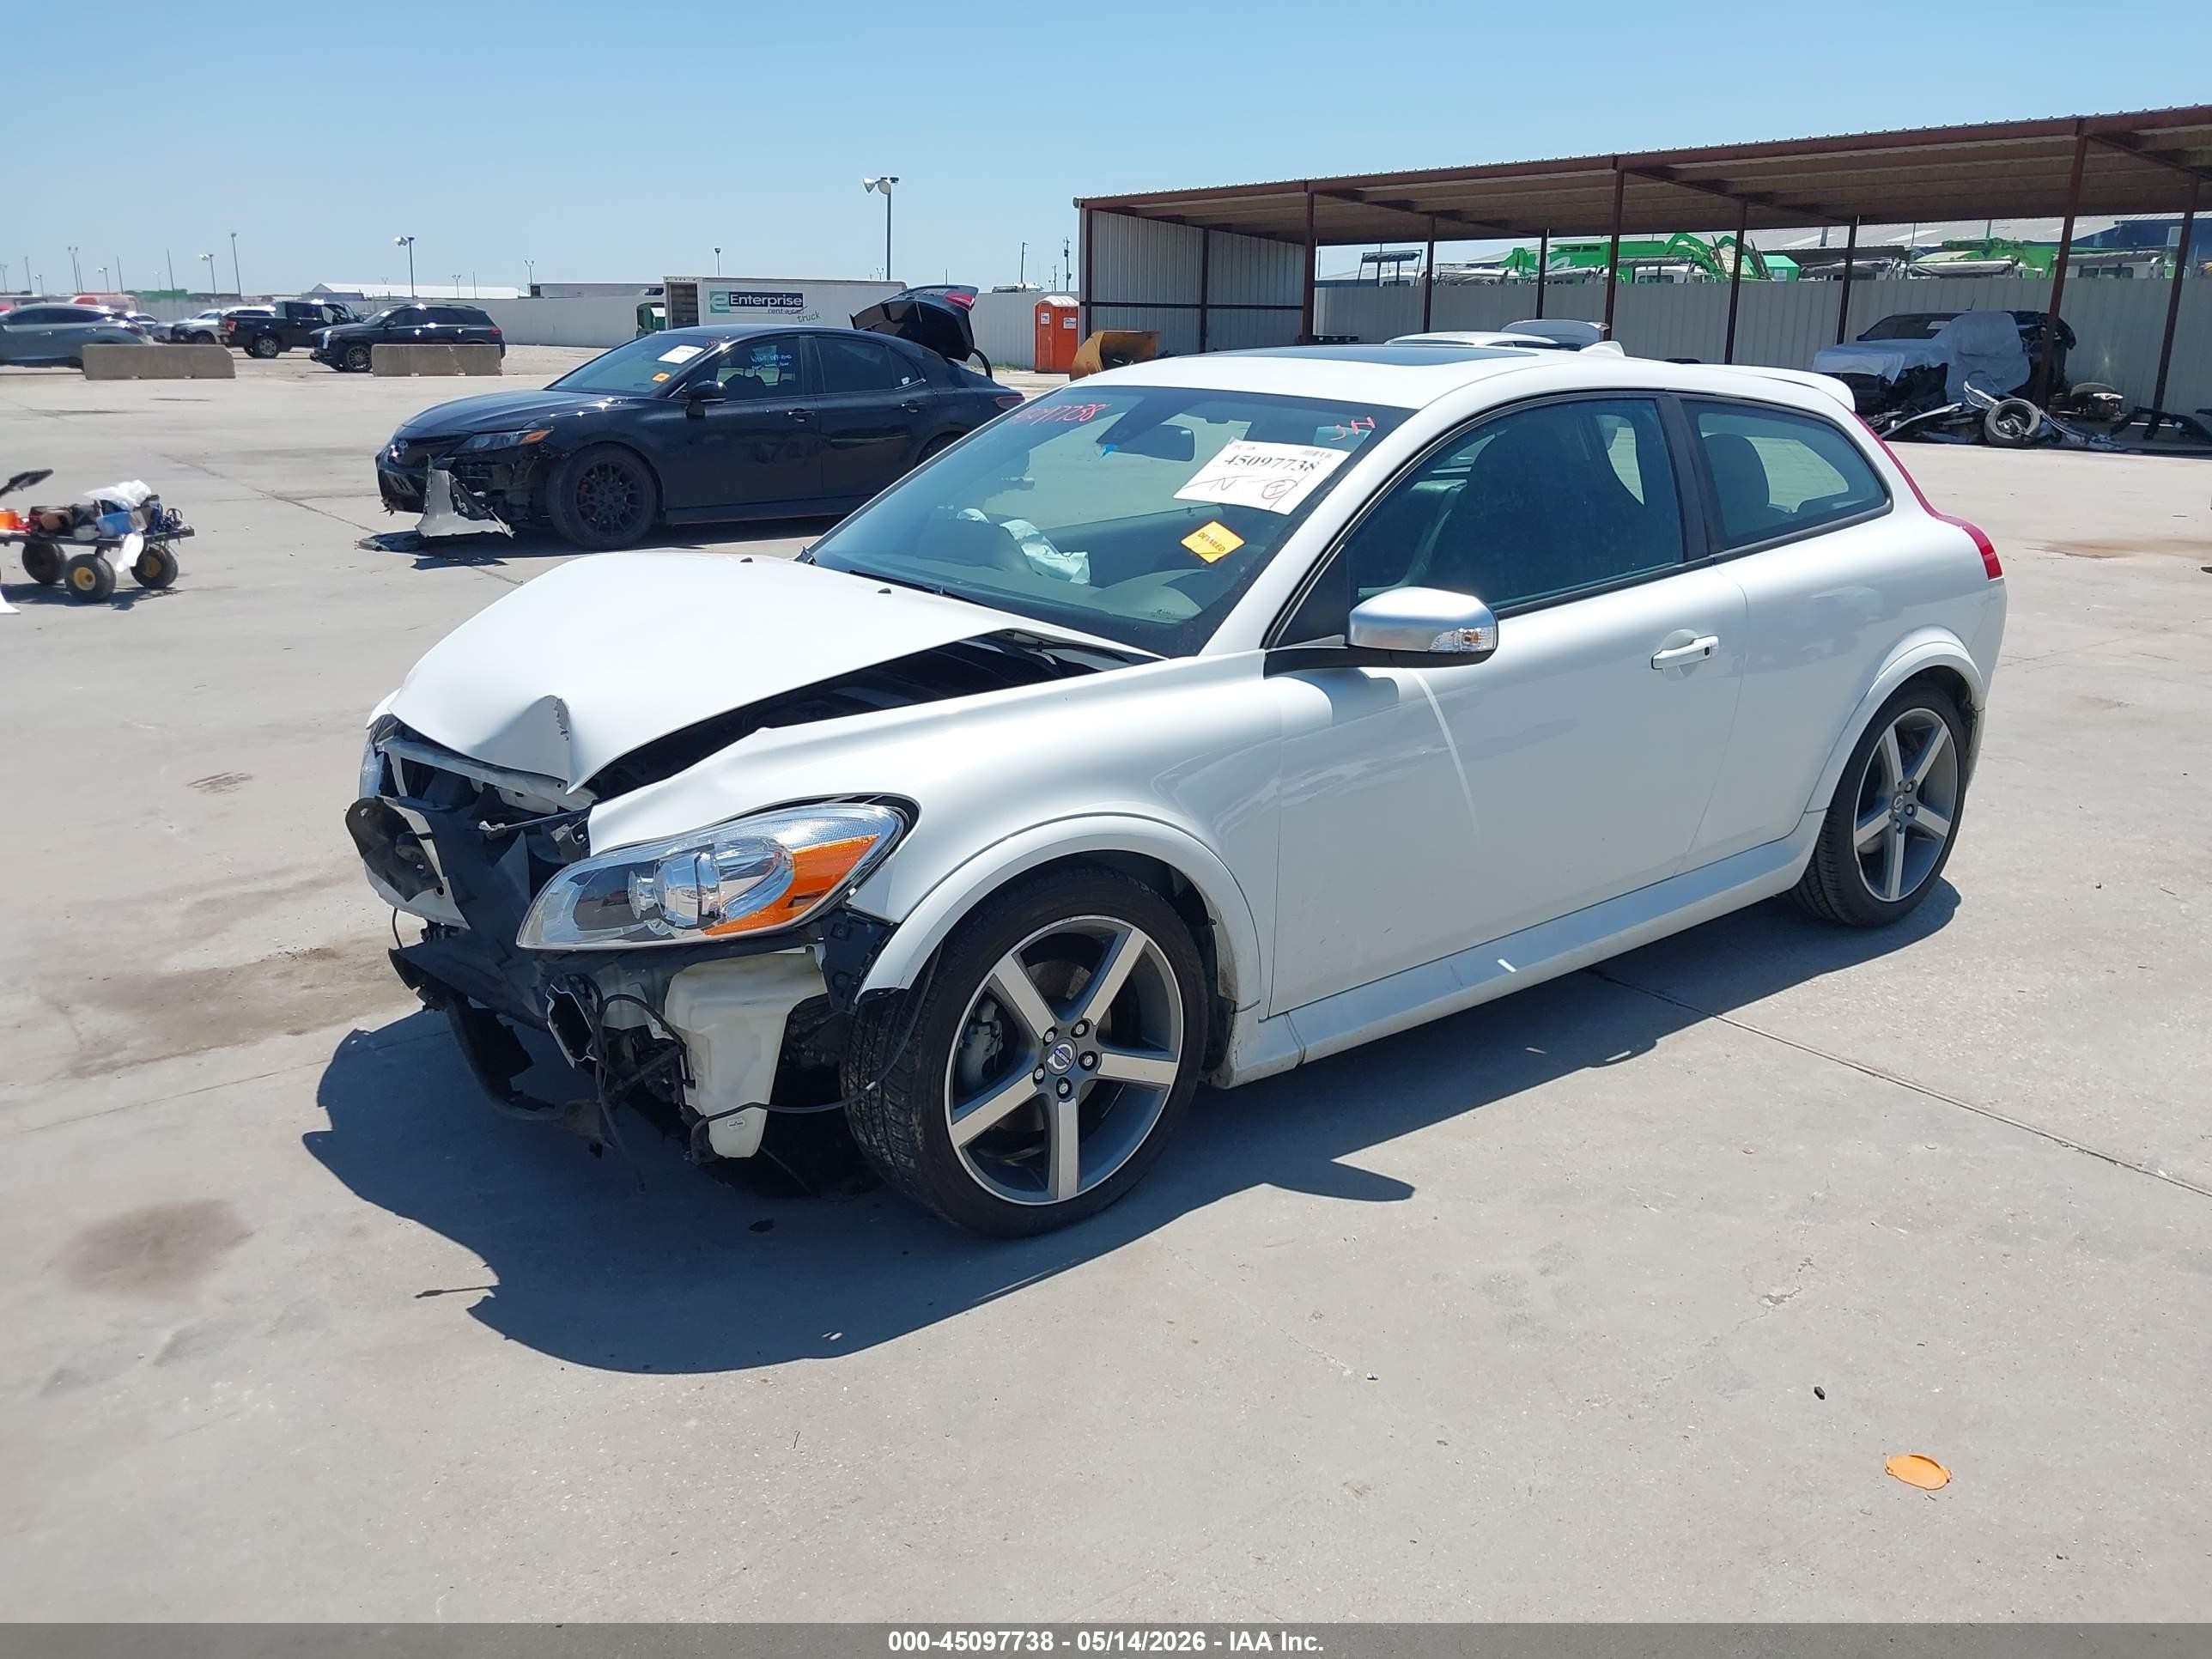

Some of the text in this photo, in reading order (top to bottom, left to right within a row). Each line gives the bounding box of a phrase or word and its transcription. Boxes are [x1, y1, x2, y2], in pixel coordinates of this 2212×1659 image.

[729, 294, 803, 307] Enterprise
[797, 311, 821, 323] truck
[1224, 454, 1320, 472] 45097738
